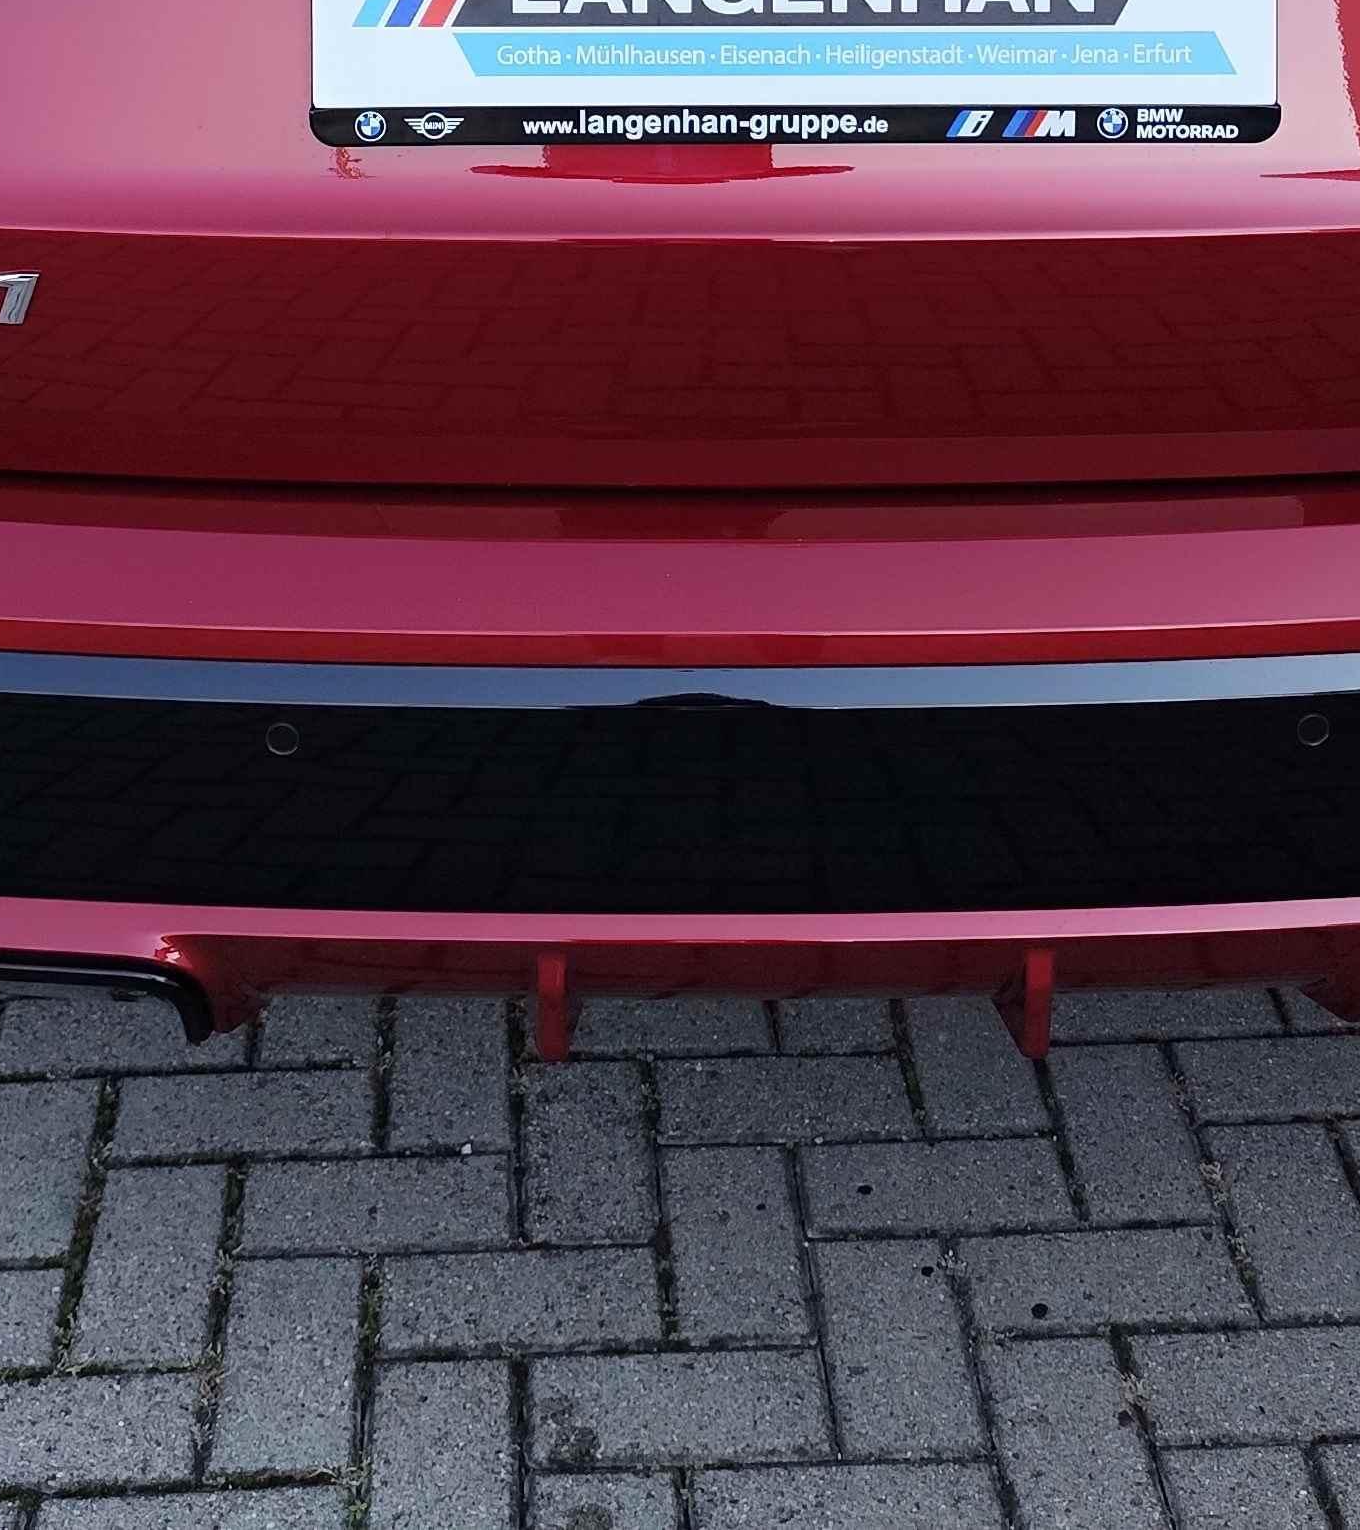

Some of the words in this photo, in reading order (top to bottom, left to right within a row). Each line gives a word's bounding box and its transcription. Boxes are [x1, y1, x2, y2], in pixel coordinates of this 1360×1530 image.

[496, 44, 562, 67] Gotha
[576, 42, 705, 67] Mühlhausen
[720, 43, 811, 67] Eisenach
[824, 42, 964, 70] Heiligenstadt
[976, 42, 1057, 65] Weimar
[1070, 43, 1119, 67] Jena
[1133, 42, 1193, 65] Erfurt
[1136, 108, 1183, 123] BMW
[424, 121, 444, 130] MINI
[522, 109, 889, 140] www.langenhan-gruppe.de
[1136, 124, 1239, 139] MOTORRAD
